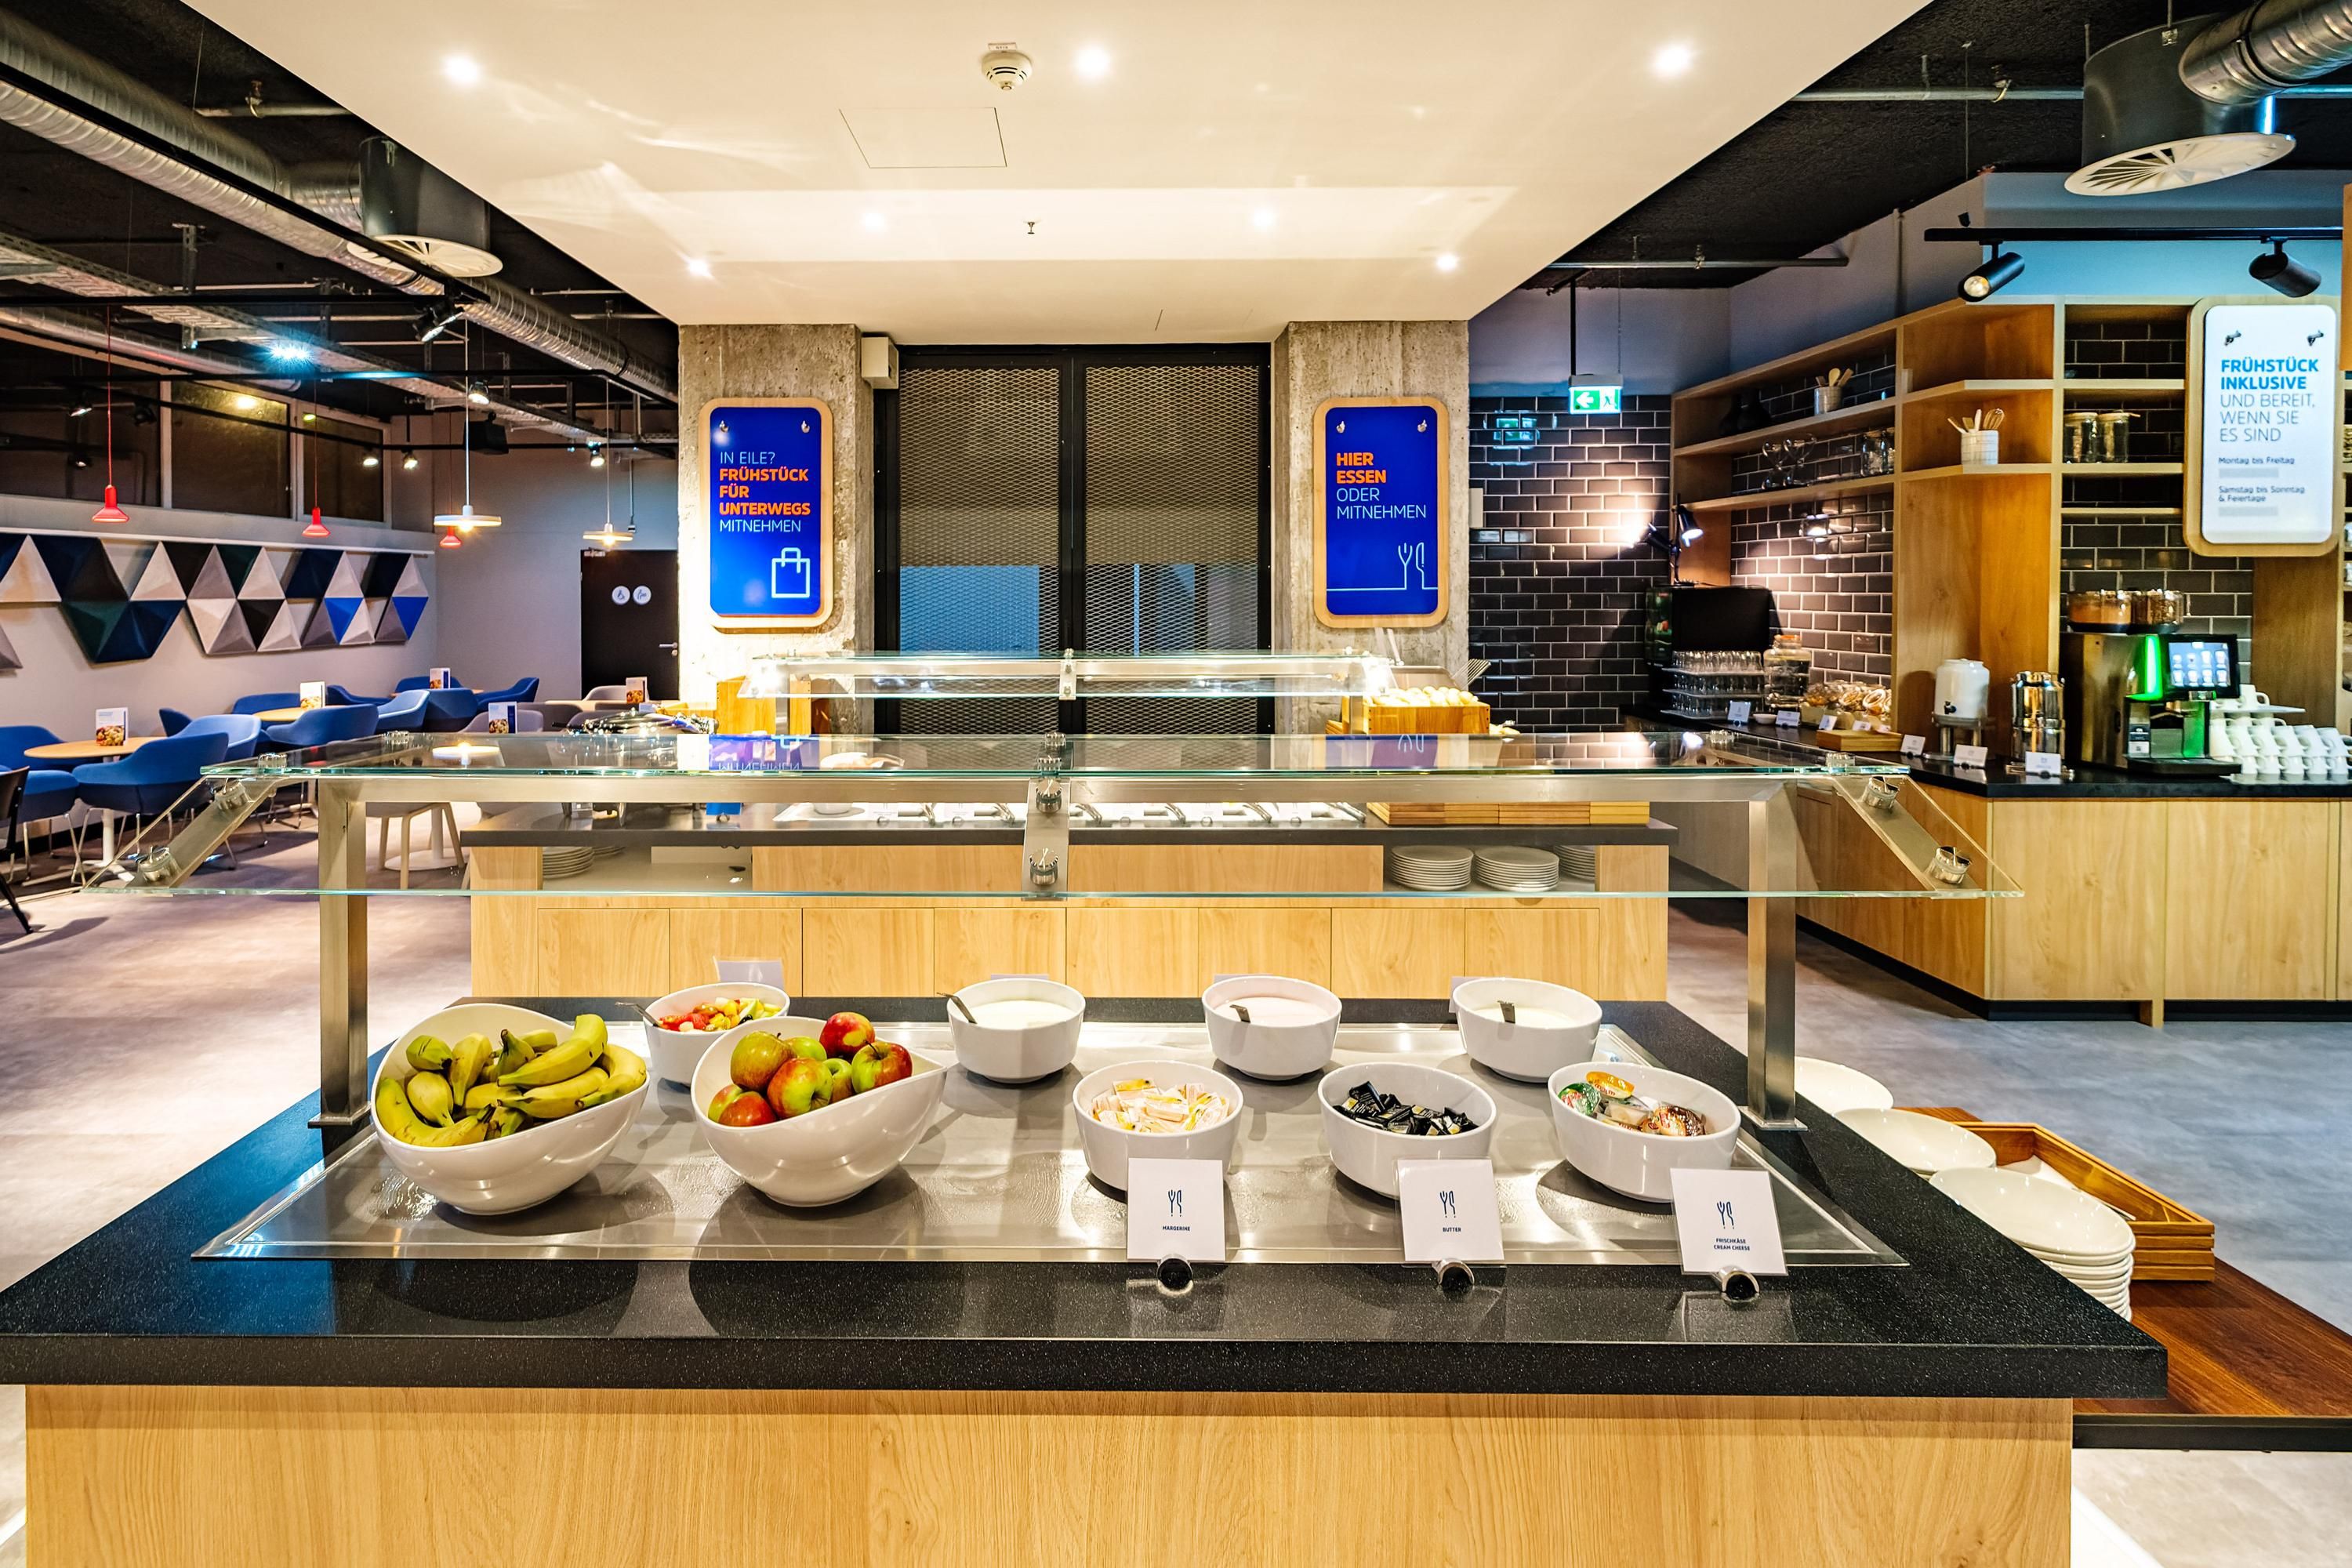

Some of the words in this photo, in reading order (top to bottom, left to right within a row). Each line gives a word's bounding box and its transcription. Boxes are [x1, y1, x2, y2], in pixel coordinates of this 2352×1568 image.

[2221, 357, 2319, 372] FRÜHSTÜCK
[2220, 376, 2307, 390] INKLUSIVE
[2220, 394, 2255, 408] UND
[2260, 394, 2315, 408] BEREIT,
[2220, 411, 2270, 424] WENN
[2277, 411, 2299, 424] SIE
[2220, 428, 2238, 442] ES
[2245, 428, 2281, 442] SIND
[720, 452, 734, 464] IN
[739, 452, 775, 464] EILE?
[1336, 452, 1374, 466] HIER
[2218, 456, 2249, 465] Montag
[2266, 456, 2296, 465] Freitag
[719, 466, 809, 481] FRÜHSTÜCK
[1336, 470, 1386, 484] ESSEN
[719, 483, 750, 498] FÜR
[1336, 488, 1380, 502] ODER
[2219, 485, 2254, 494] Samstag
[2270, 485, 2306, 494] Sonntag
[719, 503, 811, 515] UNTERWEGS
[1337, 505, 1427, 519] MITNEHMEN
[719, 520, 801, 532] MITNEHMEN
